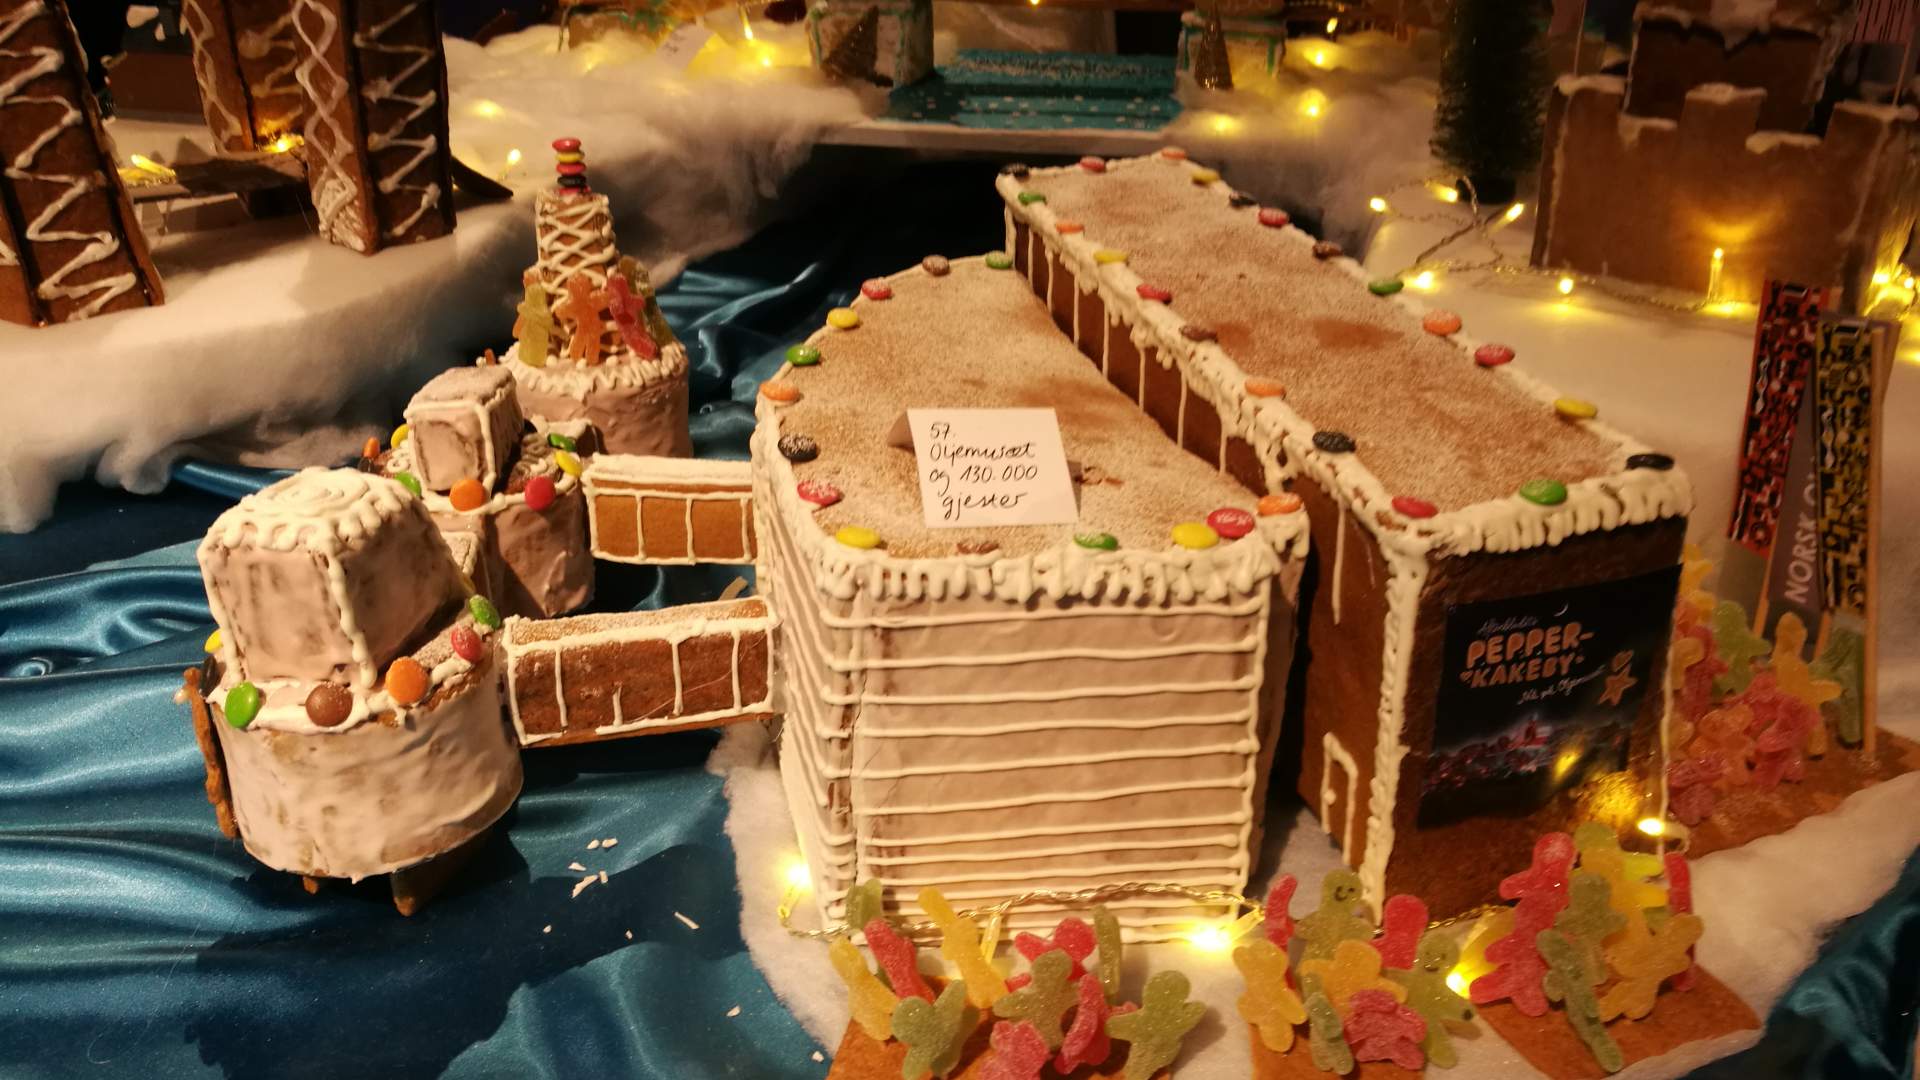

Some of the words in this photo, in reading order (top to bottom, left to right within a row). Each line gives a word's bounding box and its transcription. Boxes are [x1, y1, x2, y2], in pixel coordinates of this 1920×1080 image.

[929, 468, 950, 496] og
[942, 492, 1028, 520] gjester
[1783, 511, 1817, 603] NORSK
